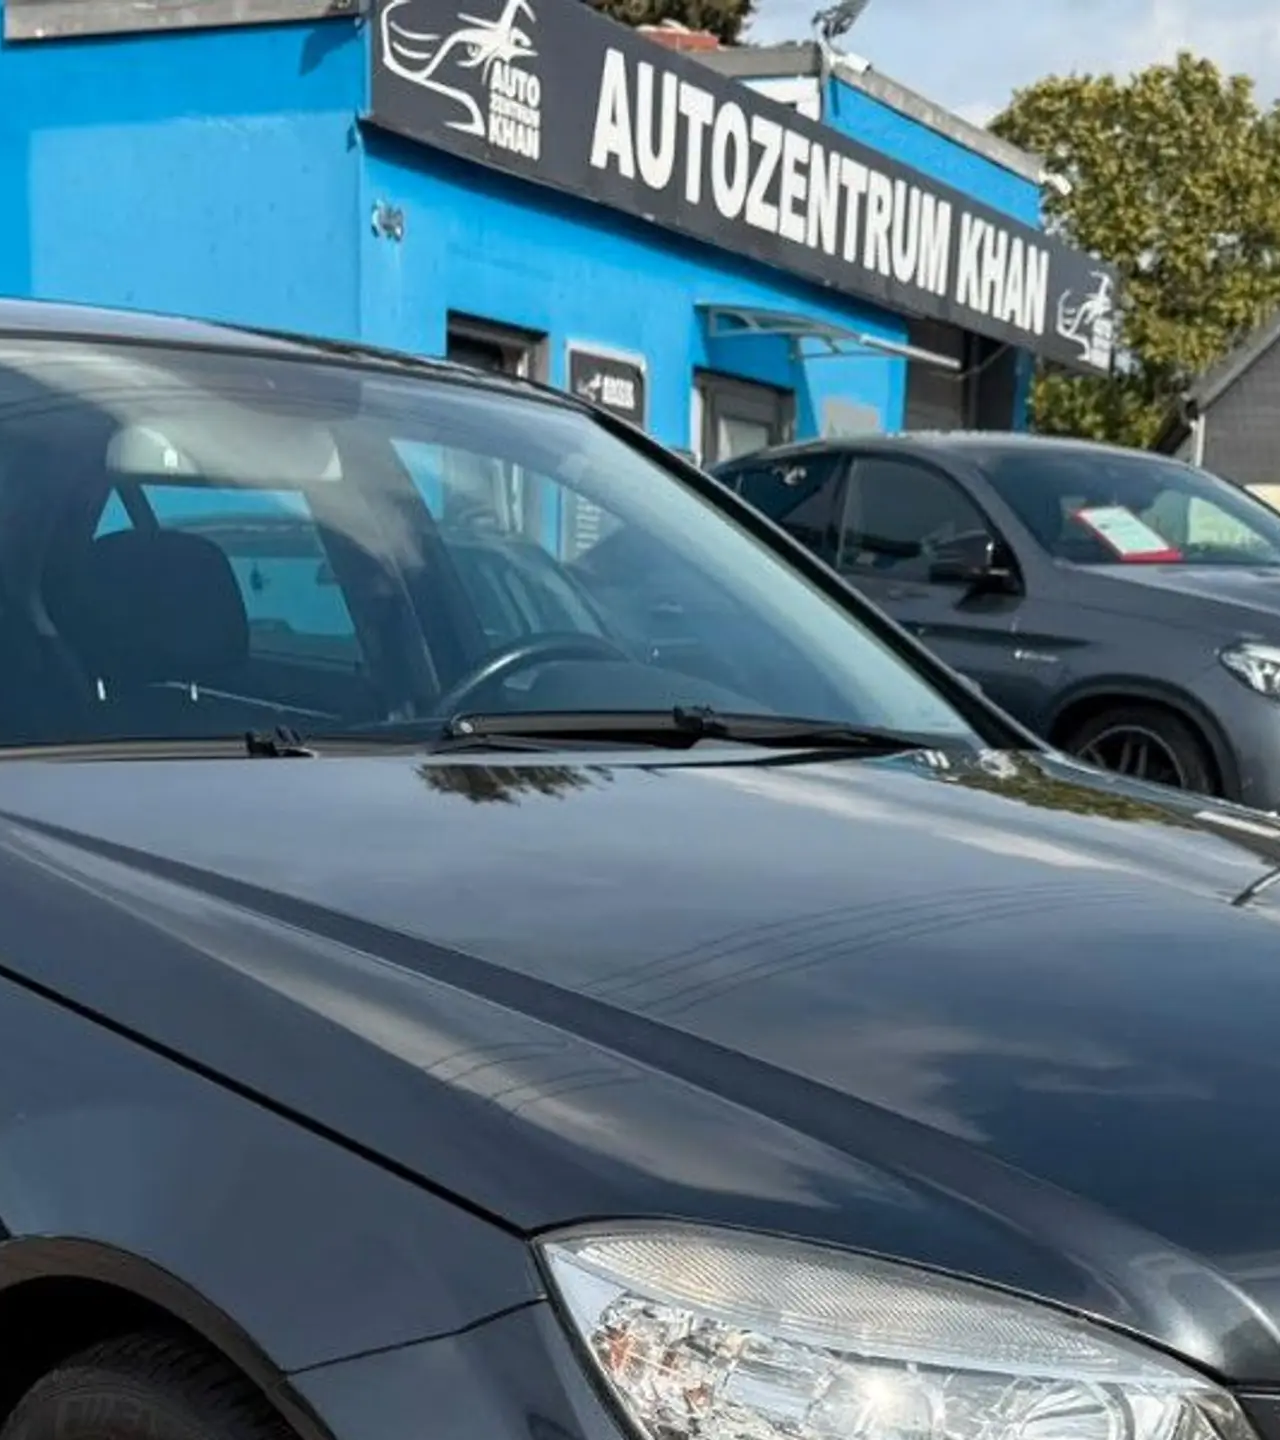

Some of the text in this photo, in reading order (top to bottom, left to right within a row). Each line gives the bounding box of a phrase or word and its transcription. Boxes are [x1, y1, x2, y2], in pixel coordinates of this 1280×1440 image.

[489, 60, 541, 108] AUTO
[488, 113, 541, 161] KHAN
[590, 47, 1050, 336] AUTOZENTRUM KHAN
